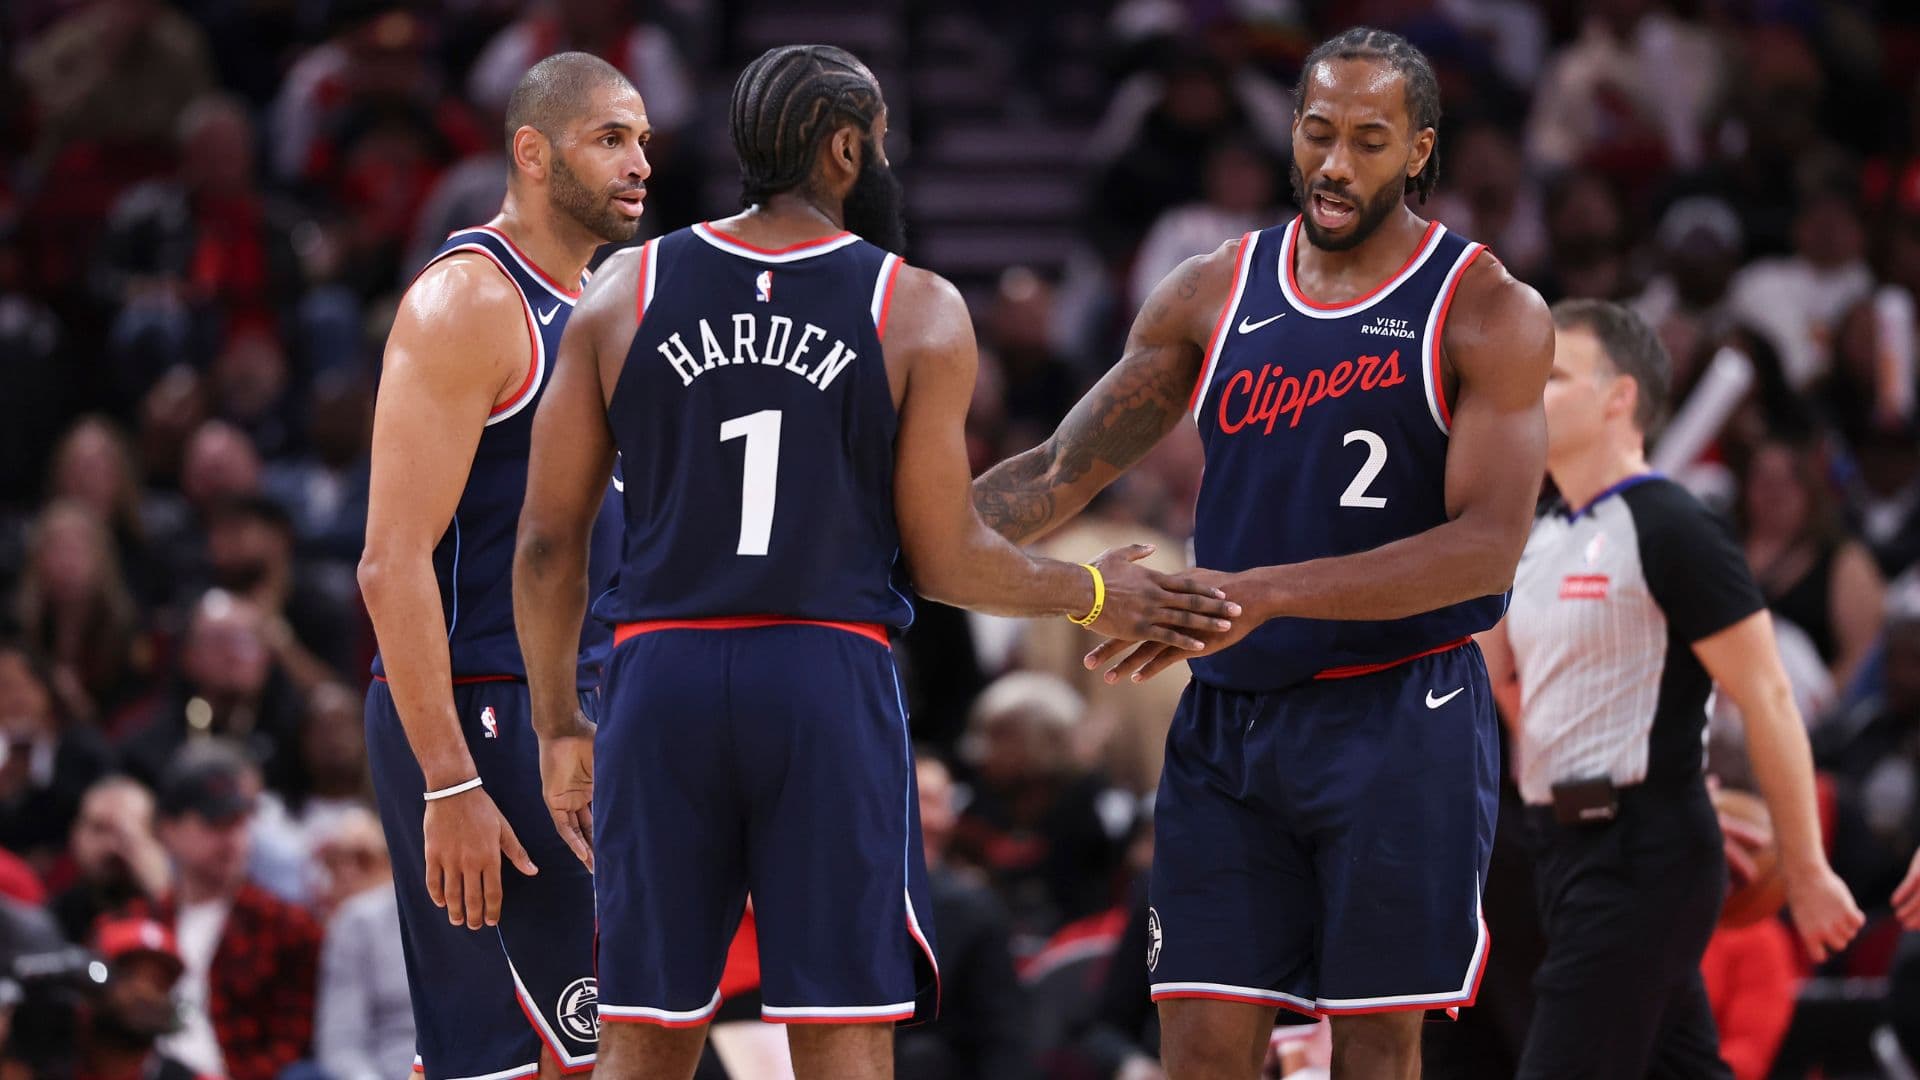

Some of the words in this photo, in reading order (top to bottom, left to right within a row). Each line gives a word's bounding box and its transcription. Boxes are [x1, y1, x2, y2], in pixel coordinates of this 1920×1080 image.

[657, 313, 857, 391] HARDEN
[1361, 324, 1415, 339] RWANDA
[1376, 317, 1408, 329] VISIT
[1218, 350, 1406, 436] Clippers
[720, 410, 782, 556] 1
[1339, 429, 1388, 508] 2
